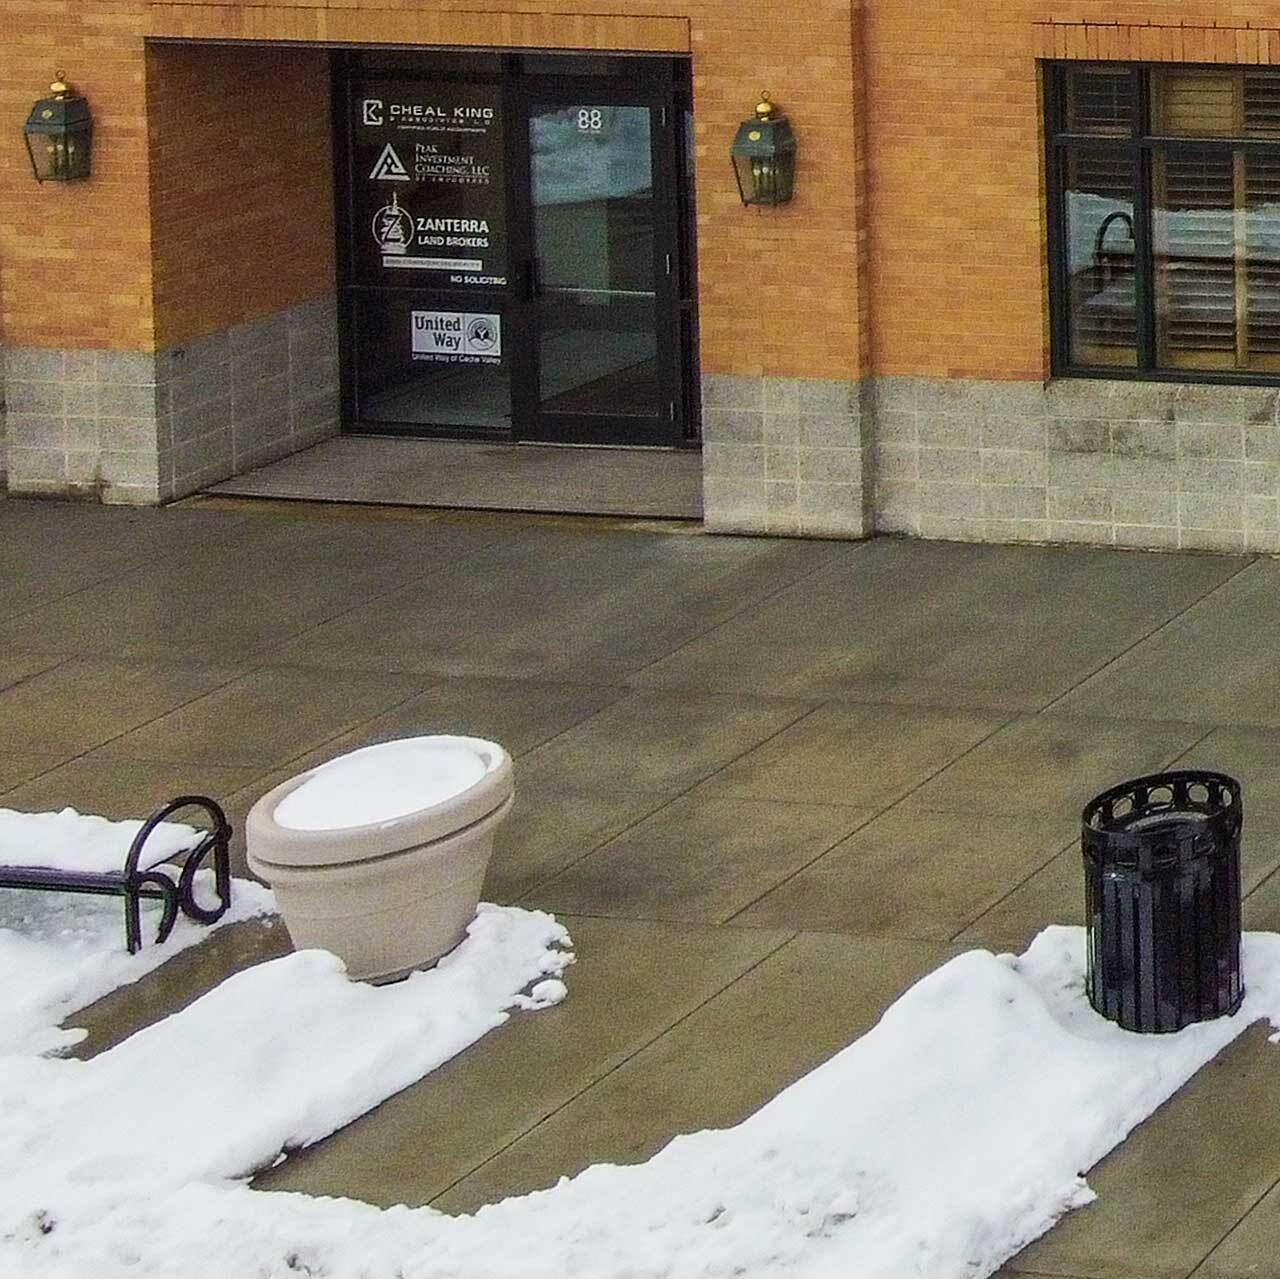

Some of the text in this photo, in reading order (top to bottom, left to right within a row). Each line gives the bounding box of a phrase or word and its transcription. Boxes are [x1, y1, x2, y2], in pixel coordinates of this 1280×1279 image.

[390, 105, 493, 118] CHEAL KING
[578, 109, 601, 128] 88
[416, 218, 489, 233] ZANTERRA
[418, 236, 489, 248] LAND BROKERS
[415, 316, 461, 331] United
[433, 332, 461, 351] Way
